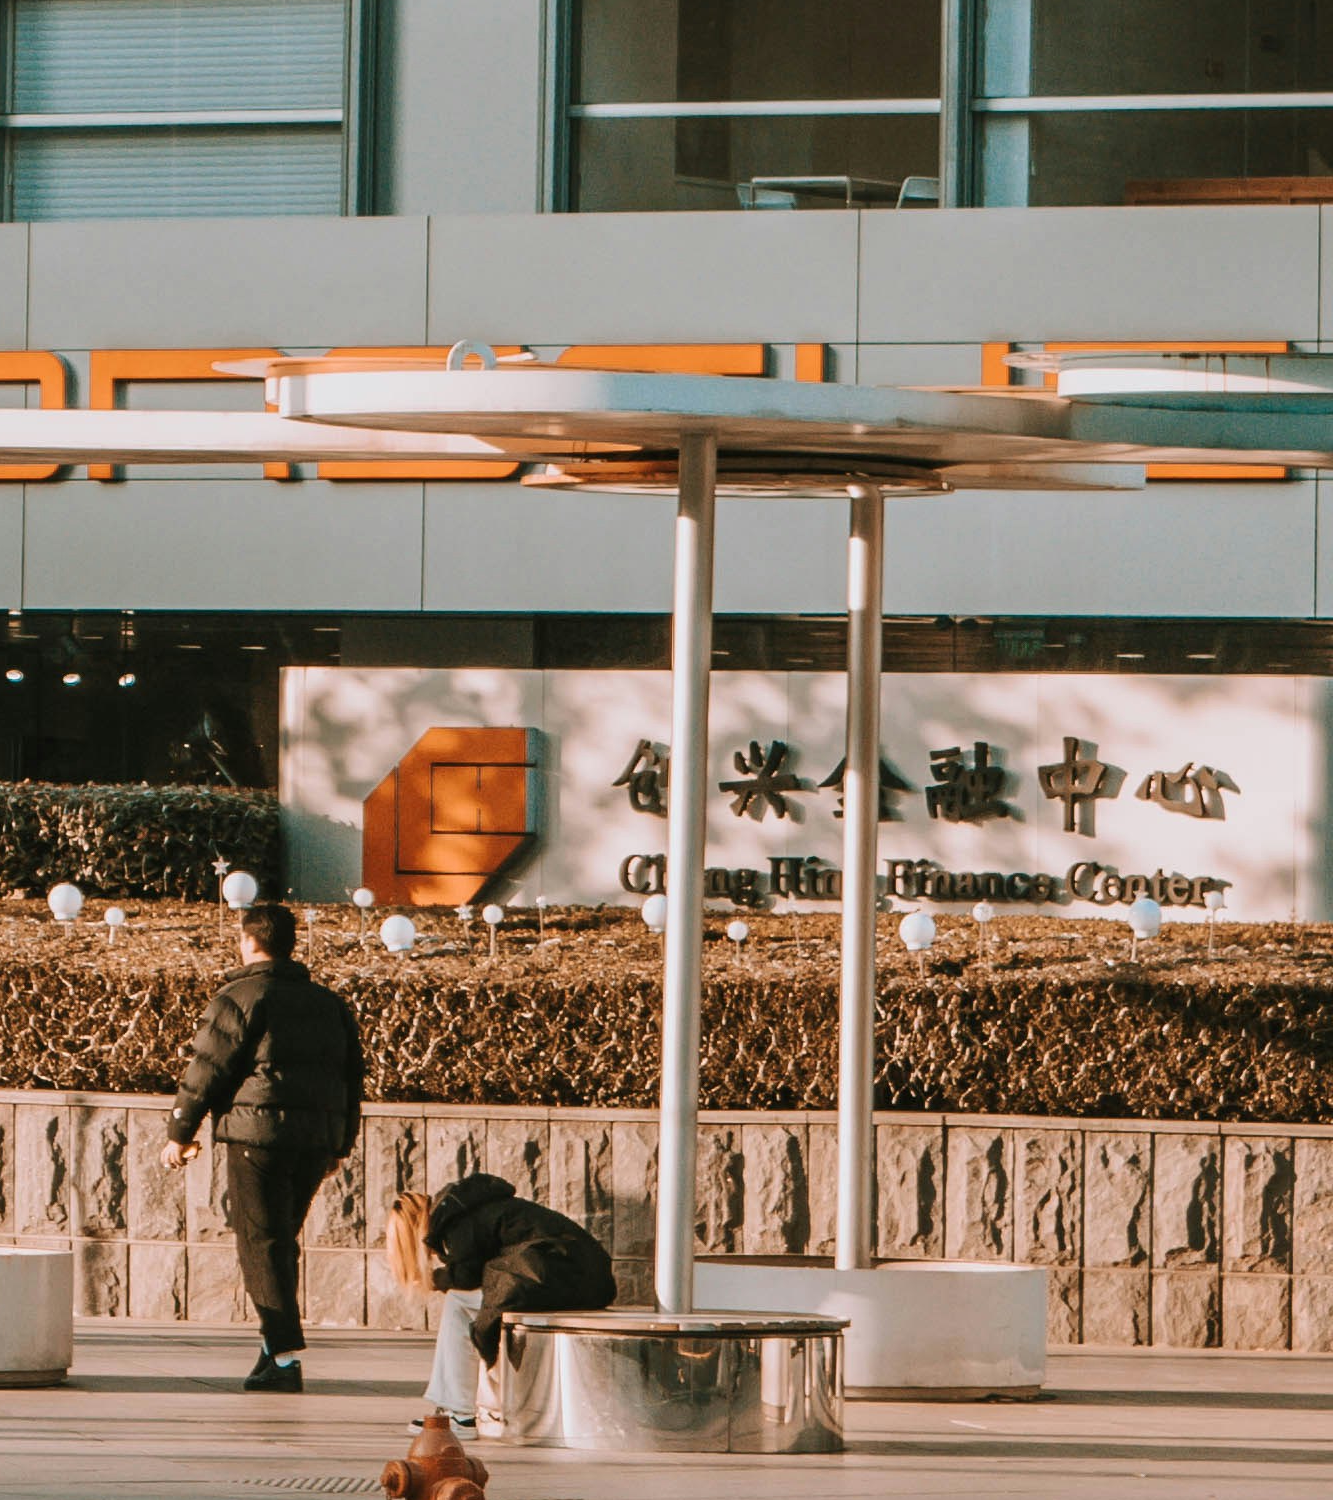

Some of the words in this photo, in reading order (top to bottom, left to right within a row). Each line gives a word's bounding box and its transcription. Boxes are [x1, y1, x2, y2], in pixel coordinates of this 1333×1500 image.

[767, 855, 844, 900] Hin
[883, 857, 1057, 902] Finance
[1065, 861, 1219, 906] Center
